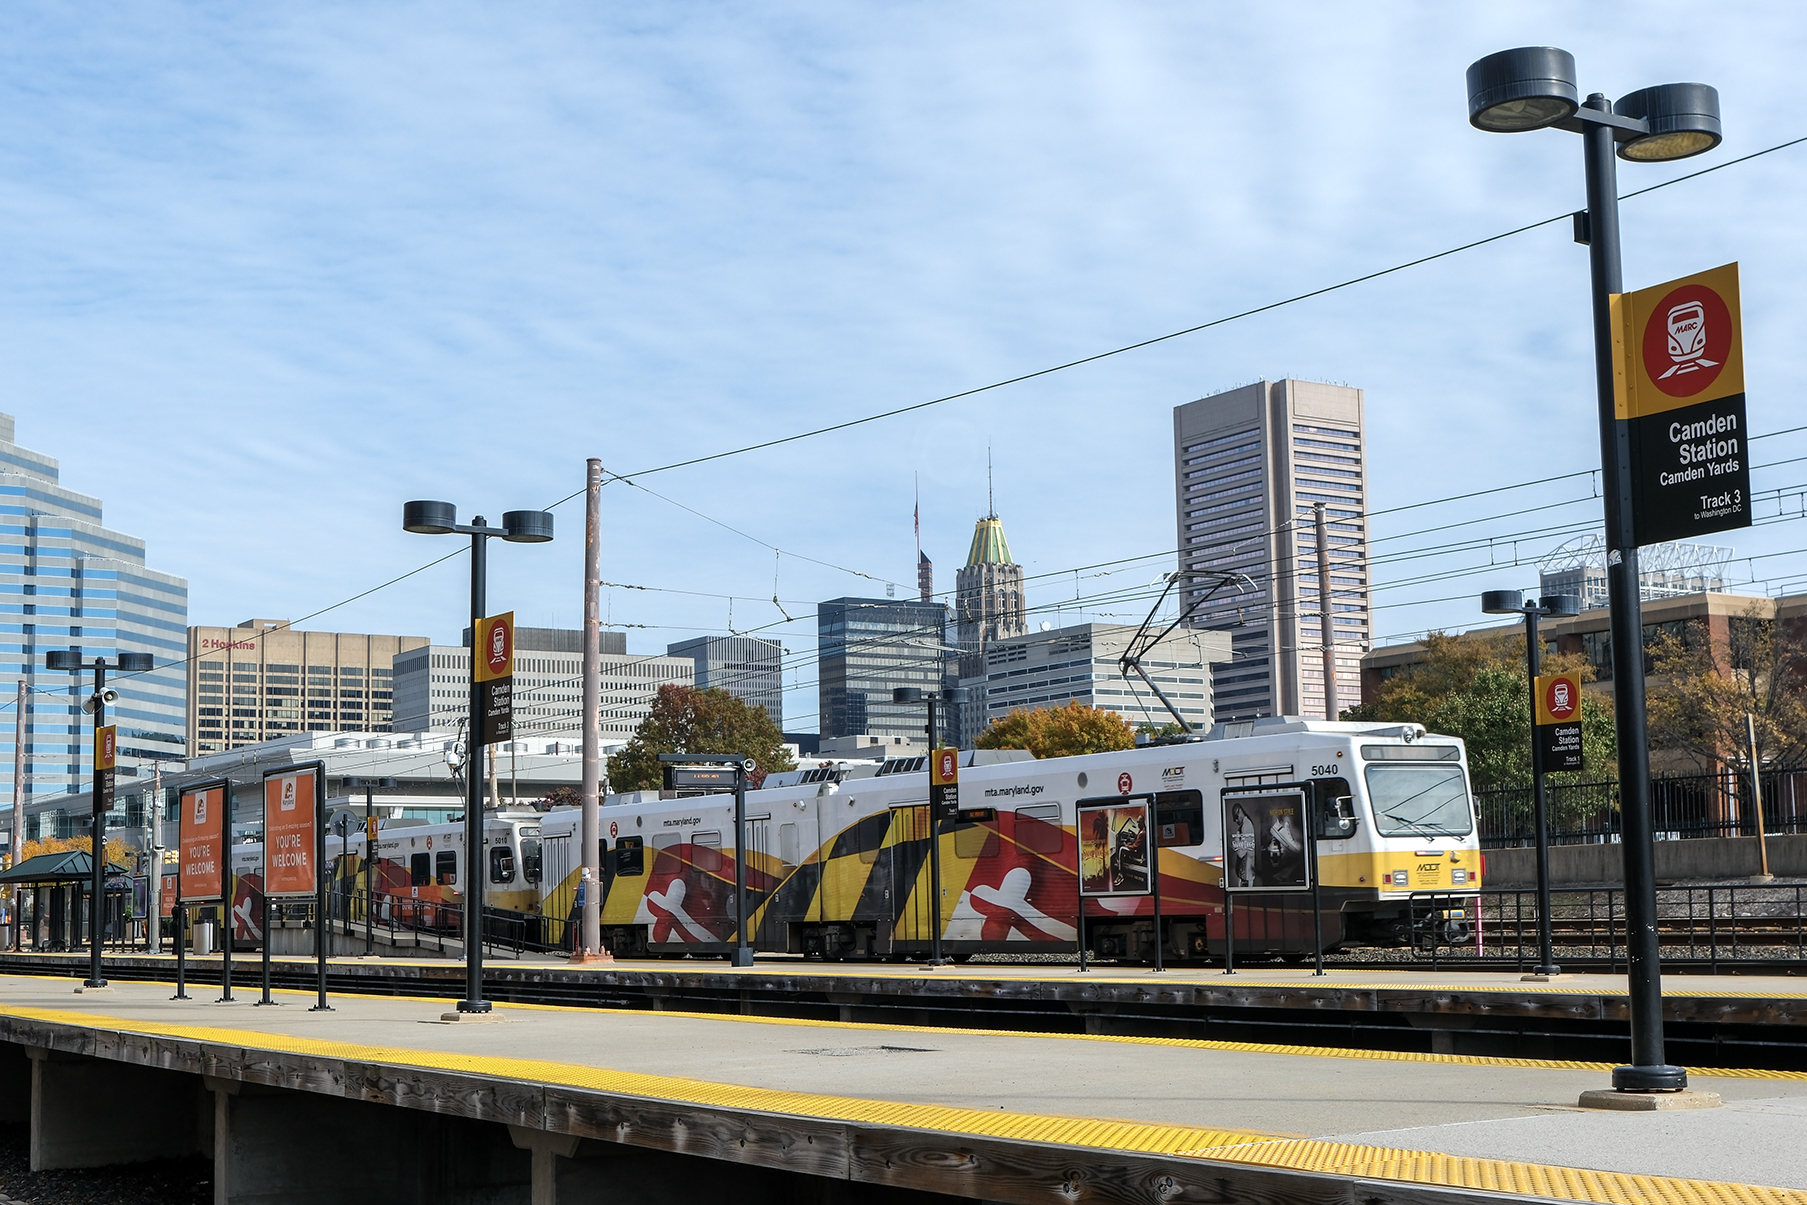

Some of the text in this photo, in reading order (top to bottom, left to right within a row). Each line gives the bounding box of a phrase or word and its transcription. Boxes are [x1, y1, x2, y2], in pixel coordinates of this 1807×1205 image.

[1674, 322, 1698, 335] MARC
[1669, 413, 1737, 443] Camden
[1679, 438, 1739, 465] Station
[1660, 458, 1740, 486] Camden Yards
[1700, 489, 1741, 510] Track 3
[1700, 506, 1732, 519] Washington
[1732, 504, 1742, 513] DC
[202, 639, 255, 651] 2 Hopkins
[491, 684, 510, 696] Camden
[493, 695, 510, 707] Station
[1554, 727, 1580, 736] Camden
[1558, 736, 1580, 744] Station
[1311, 764, 1338, 776] 5040
[985, 784, 1044, 798] mta.maryland.gov
[663, 816, 701, 827] mta.maryland.gov
[275, 834, 301, 849] YOU'RE
[188, 844, 210, 858] YOU'RE
[272, 852, 307, 867] WELCOME
[185, 861, 215, 876] WELCOME
